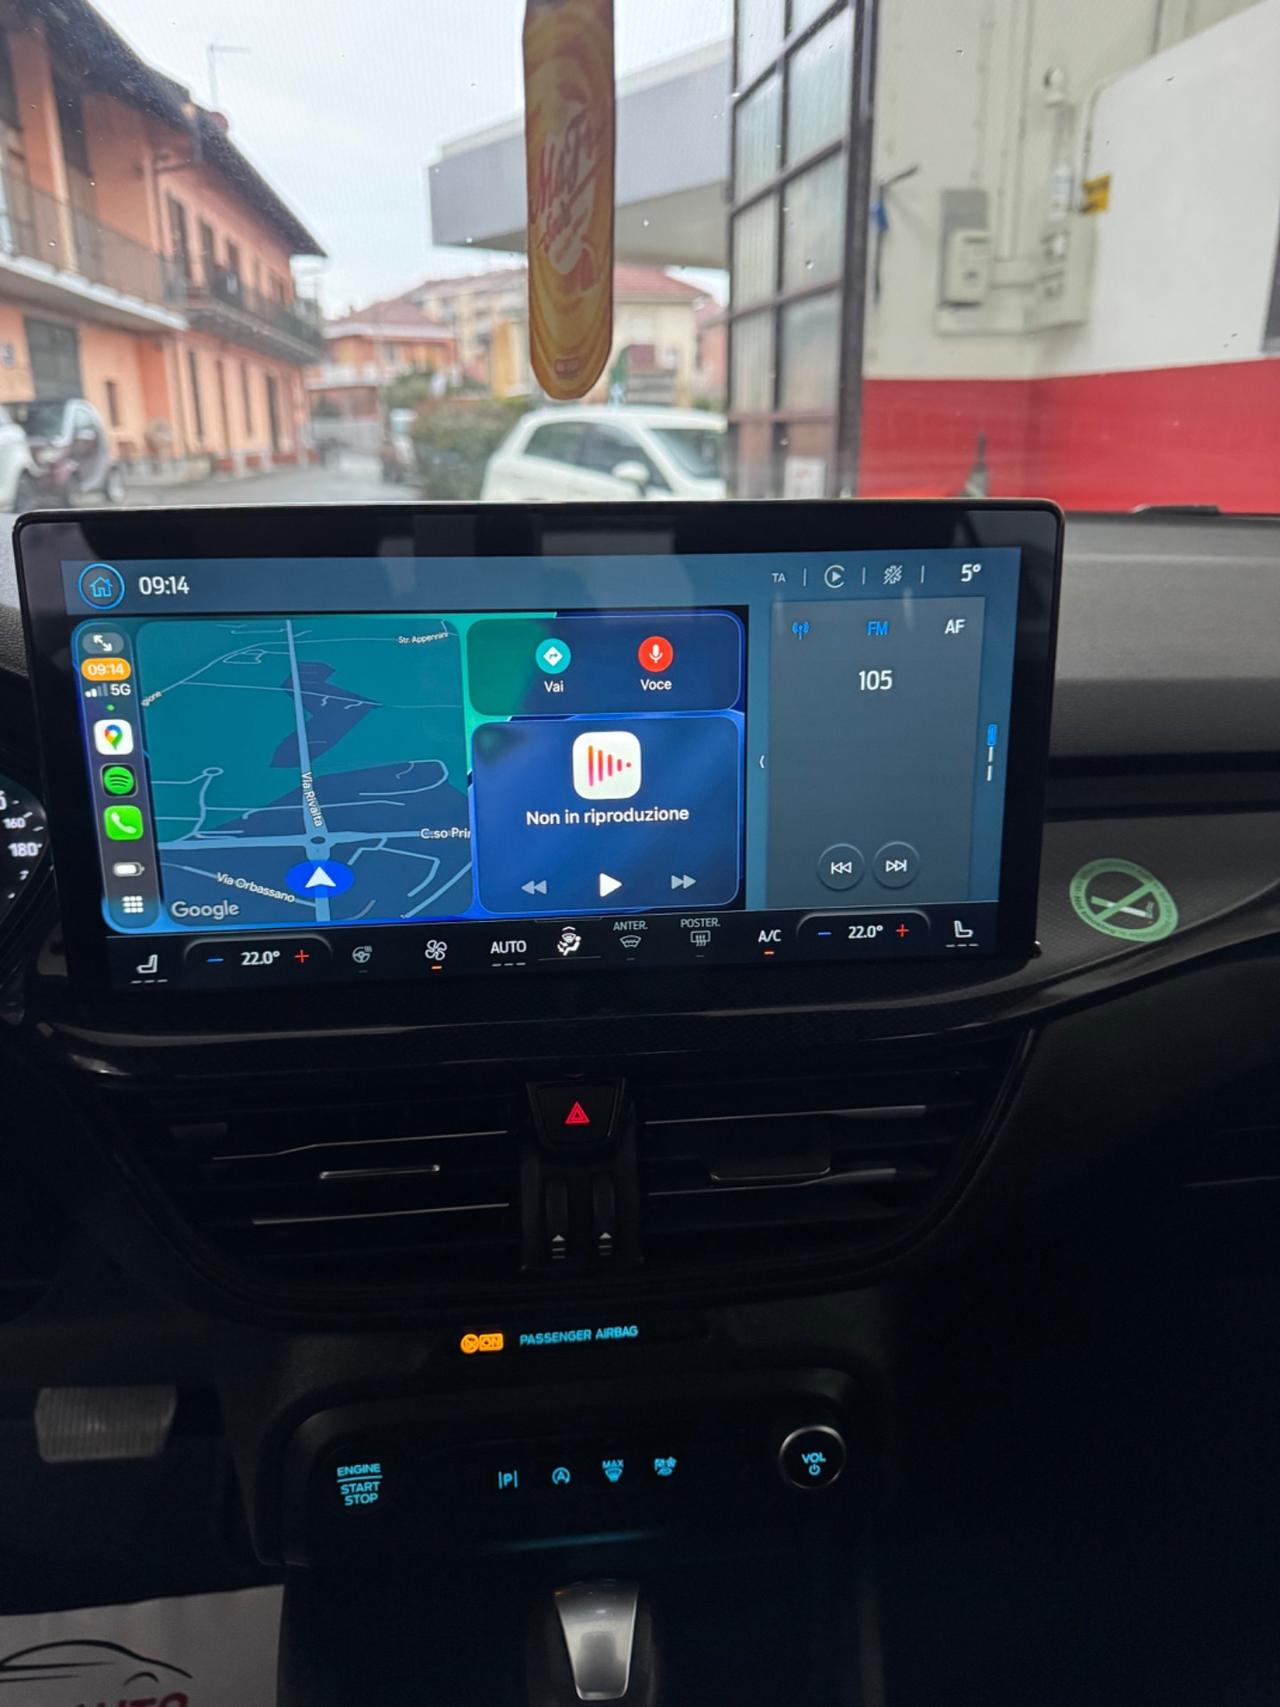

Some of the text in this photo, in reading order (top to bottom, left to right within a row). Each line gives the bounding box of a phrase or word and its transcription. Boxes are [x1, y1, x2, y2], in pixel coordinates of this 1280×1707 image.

[771, 572, 786, 583] TA
[138, 575, 191, 596] 09:14
[867, 620, 889, 636] FM
[944, 618, 966, 635] AF
[87, 663, 125, 676] 09:14
[543, 680, 565, 693] Vai
[640, 677, 673, 692] Voce
[857, 669, 893, 691] 105
[110, 683, 132, 696] 5G
[302, 771, 324, 828] Via Rivalta
[3, 817, 27, 829] 160
[525, 804, 690, 828] Non in riproduzione
[8, 842, 39, 857] 180
[217, 872, 296, 903] Via Orbassano
[171, 899, 240, 921] Google
[612, 920, 648, 931] ANTER.
[680, 917, 721, 928] POSTER.
[757, 929, 782, 943] A/C
[847, 924, 884, 940] 22.0°
[490, 940, 527, 954] AUTO
[241, 949, 281, 966] 22.0°
[519, 1325, 639, 1346] PASSENGER AIRBAG
[602, 1459, 624, 1469] MAX
[801, 1451, 827, 1464] VOL
[336, 1463, 381, 1477] ENGINE
[340, 1481, 381, 1495] START
[344, 1492, 379, 1506] STOP
